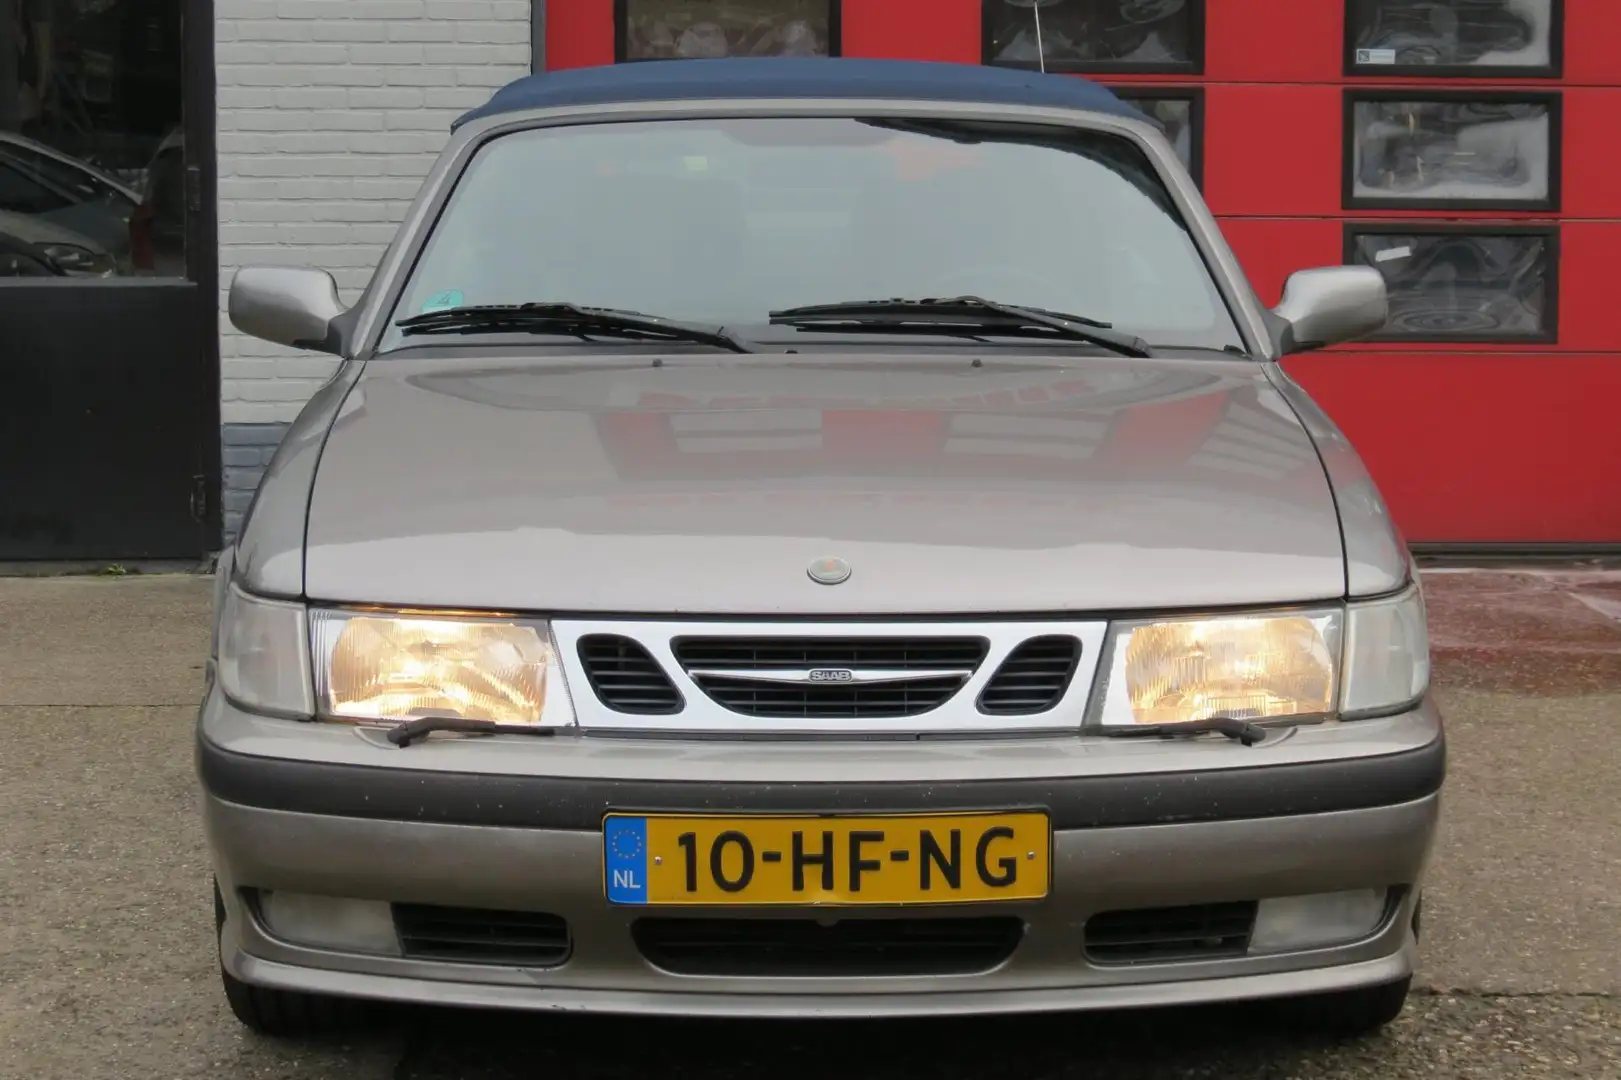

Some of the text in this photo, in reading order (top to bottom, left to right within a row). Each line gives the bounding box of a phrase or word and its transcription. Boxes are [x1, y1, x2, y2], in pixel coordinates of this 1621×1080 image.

[811, 671, 850, 681] SAAB
[678, 826, 1017, 892] 10-HF-NG
[613, 869, 641, 889] NL
